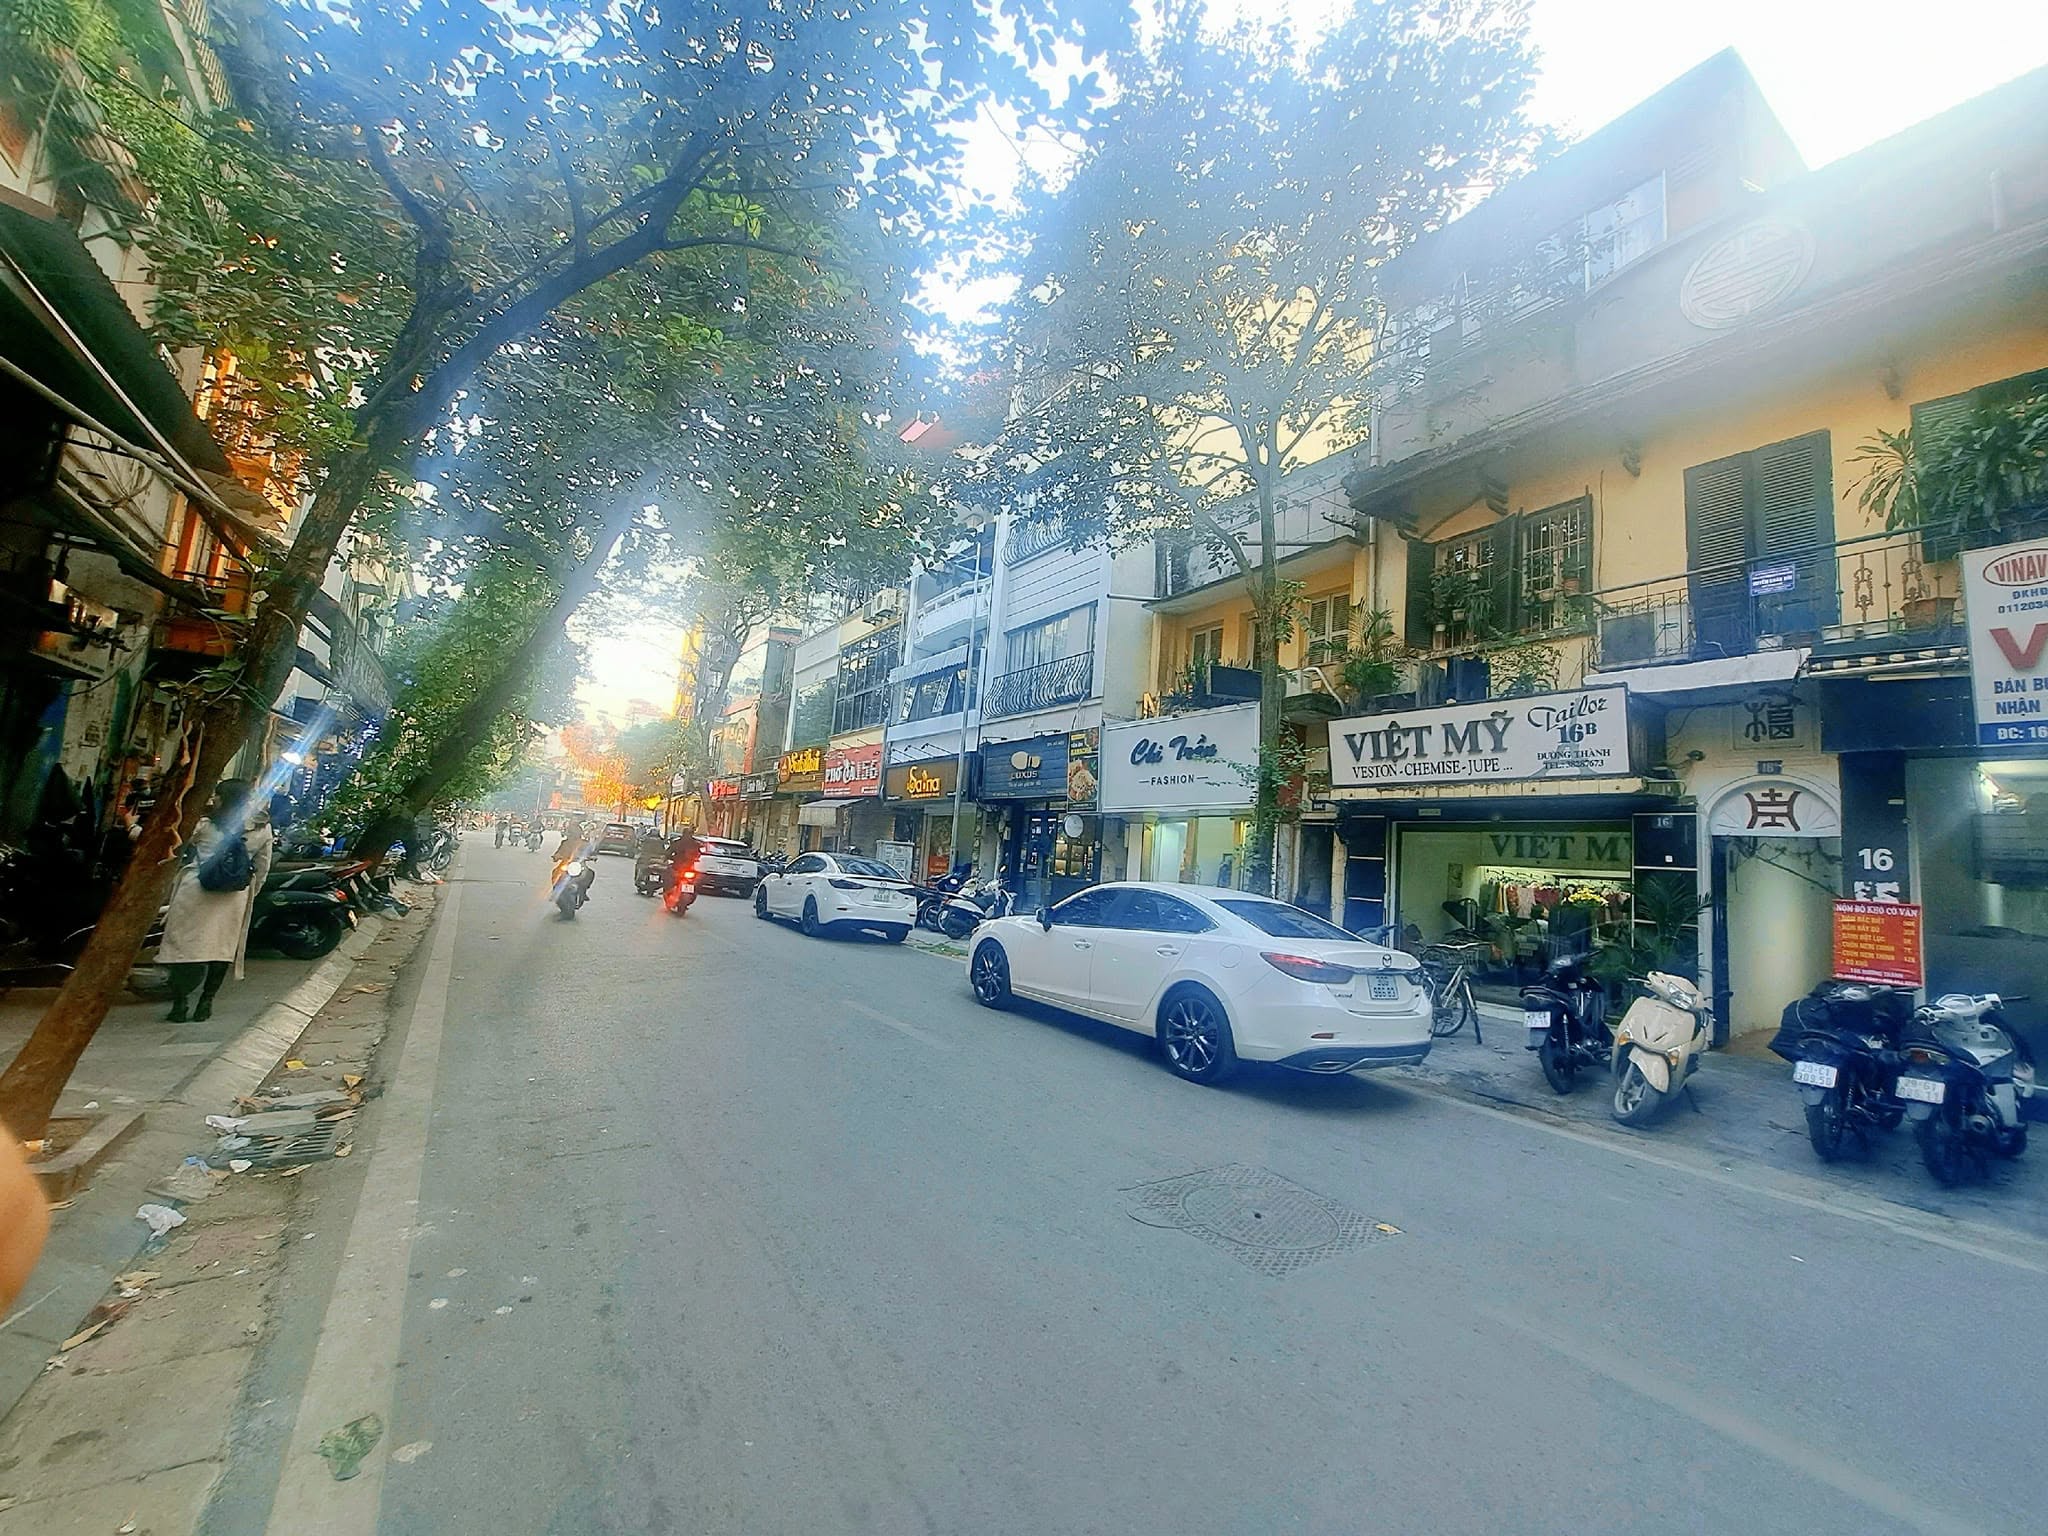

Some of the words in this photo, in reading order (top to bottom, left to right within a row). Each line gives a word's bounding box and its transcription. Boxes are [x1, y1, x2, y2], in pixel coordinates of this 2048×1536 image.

[1994, 678, 2026, 694] BÁN
[1996, 697, 2040, 716] NHẬN
[1343, 720, 1432, 763] VIỆT
[1441, 710, 1515, 756] MỸ
[1352, 763, 1398, 779] VESTON
[1404, 760, 1461, 777] CHEMISE
[1468, 758, 1500, 776] JUPE
[1151, 774, 1195, 786] FASHION
[1858, 848, 1894, 872] 16
